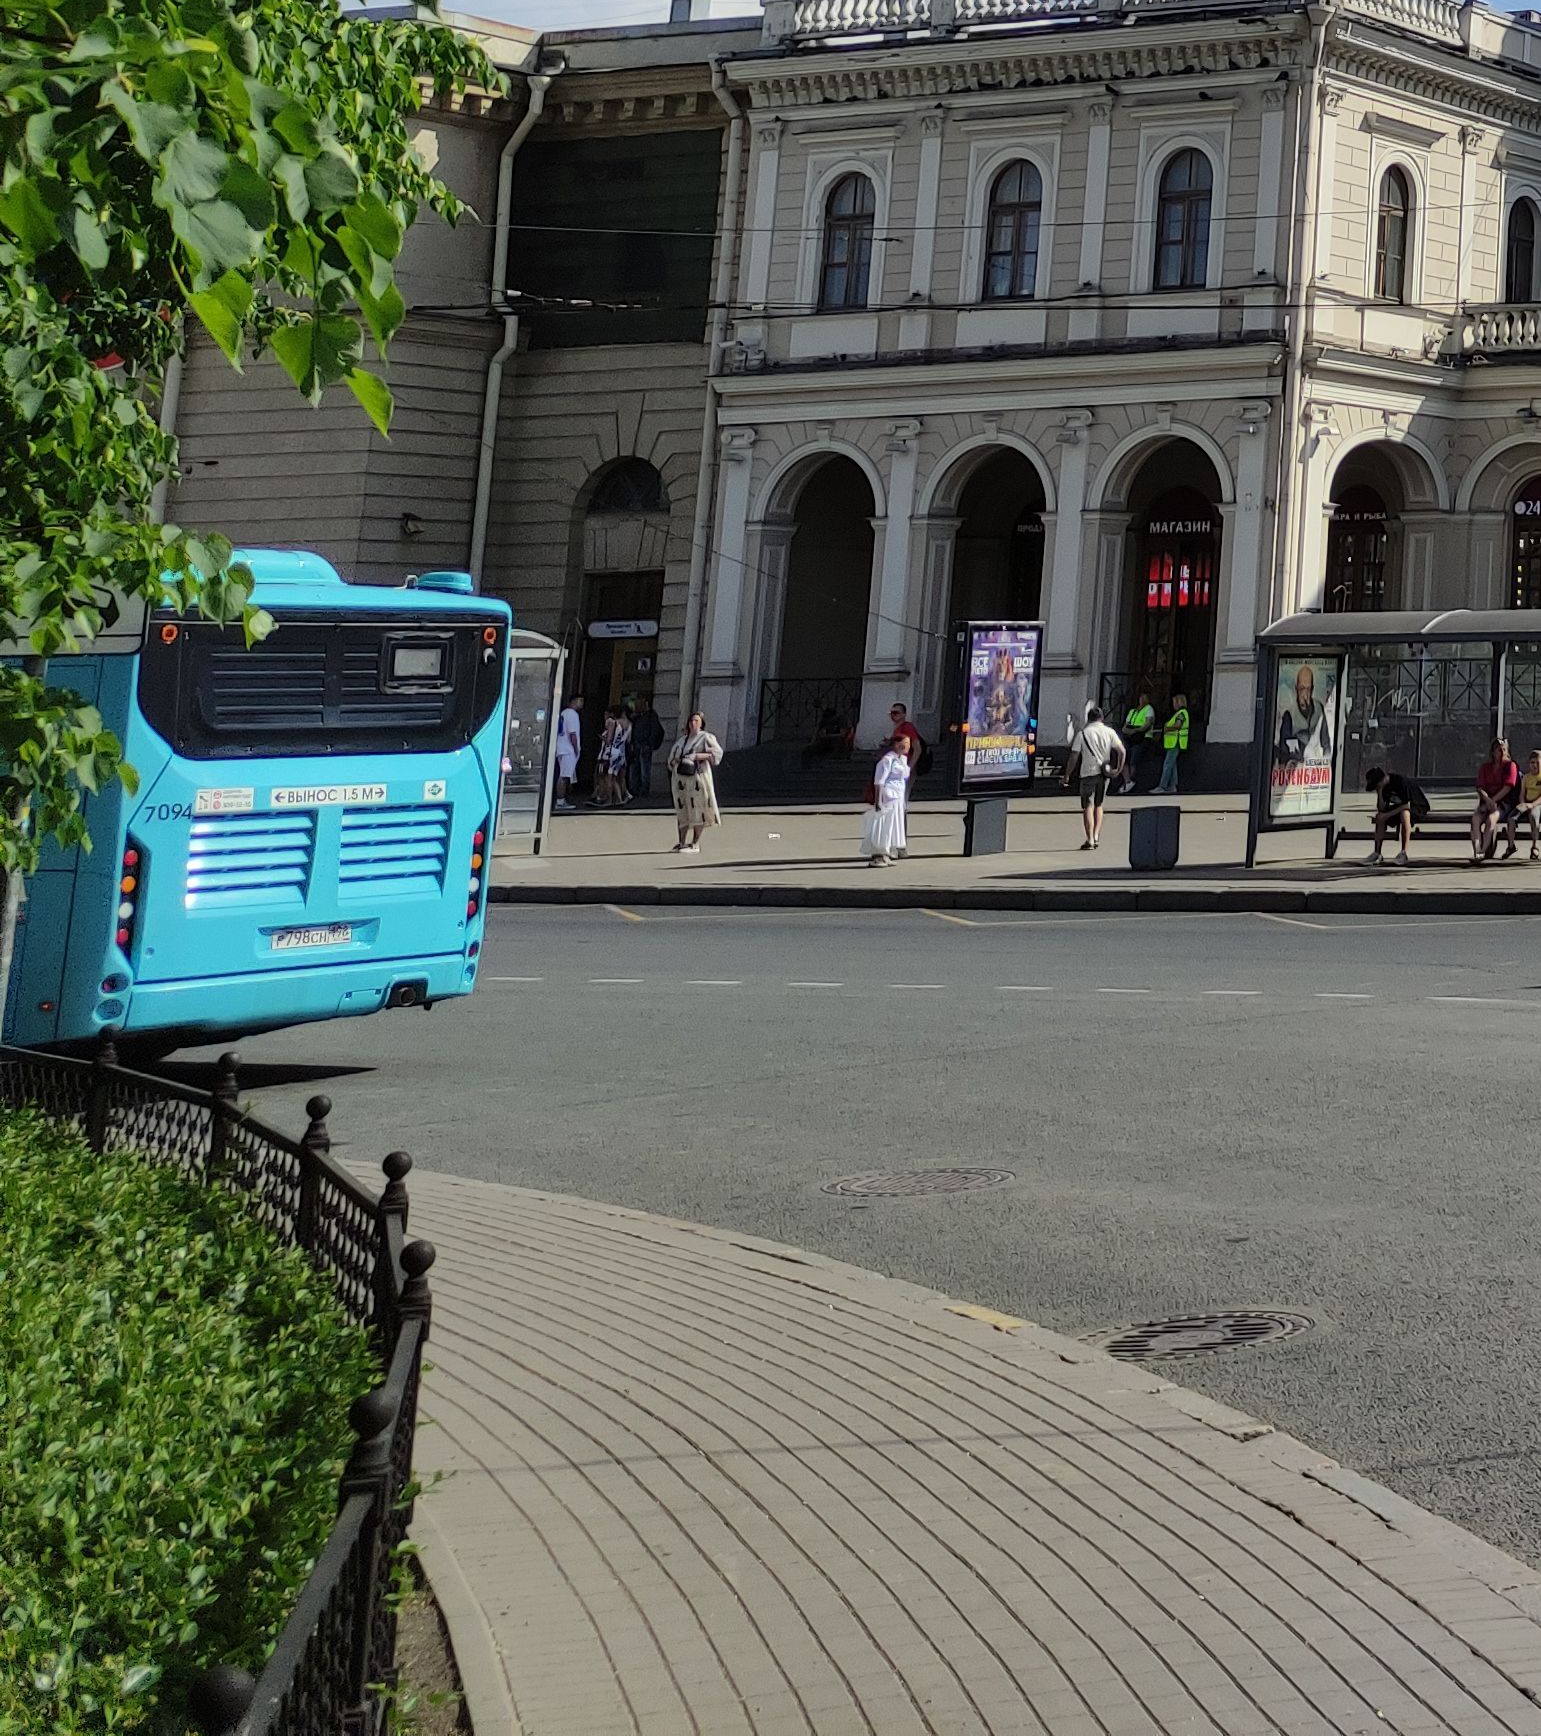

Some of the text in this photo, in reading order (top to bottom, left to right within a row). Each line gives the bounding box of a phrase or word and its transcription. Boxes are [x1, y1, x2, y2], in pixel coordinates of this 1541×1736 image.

[1149, 520, 1211, 534] МАГАЗИН
[1272, 766, 1330, 787] РОЗЕНБАУМ
[287, 787, 338, 804] ВЫНОС
[361, 785, 374, 800] М
[144, 803, 192, 823] 7094
